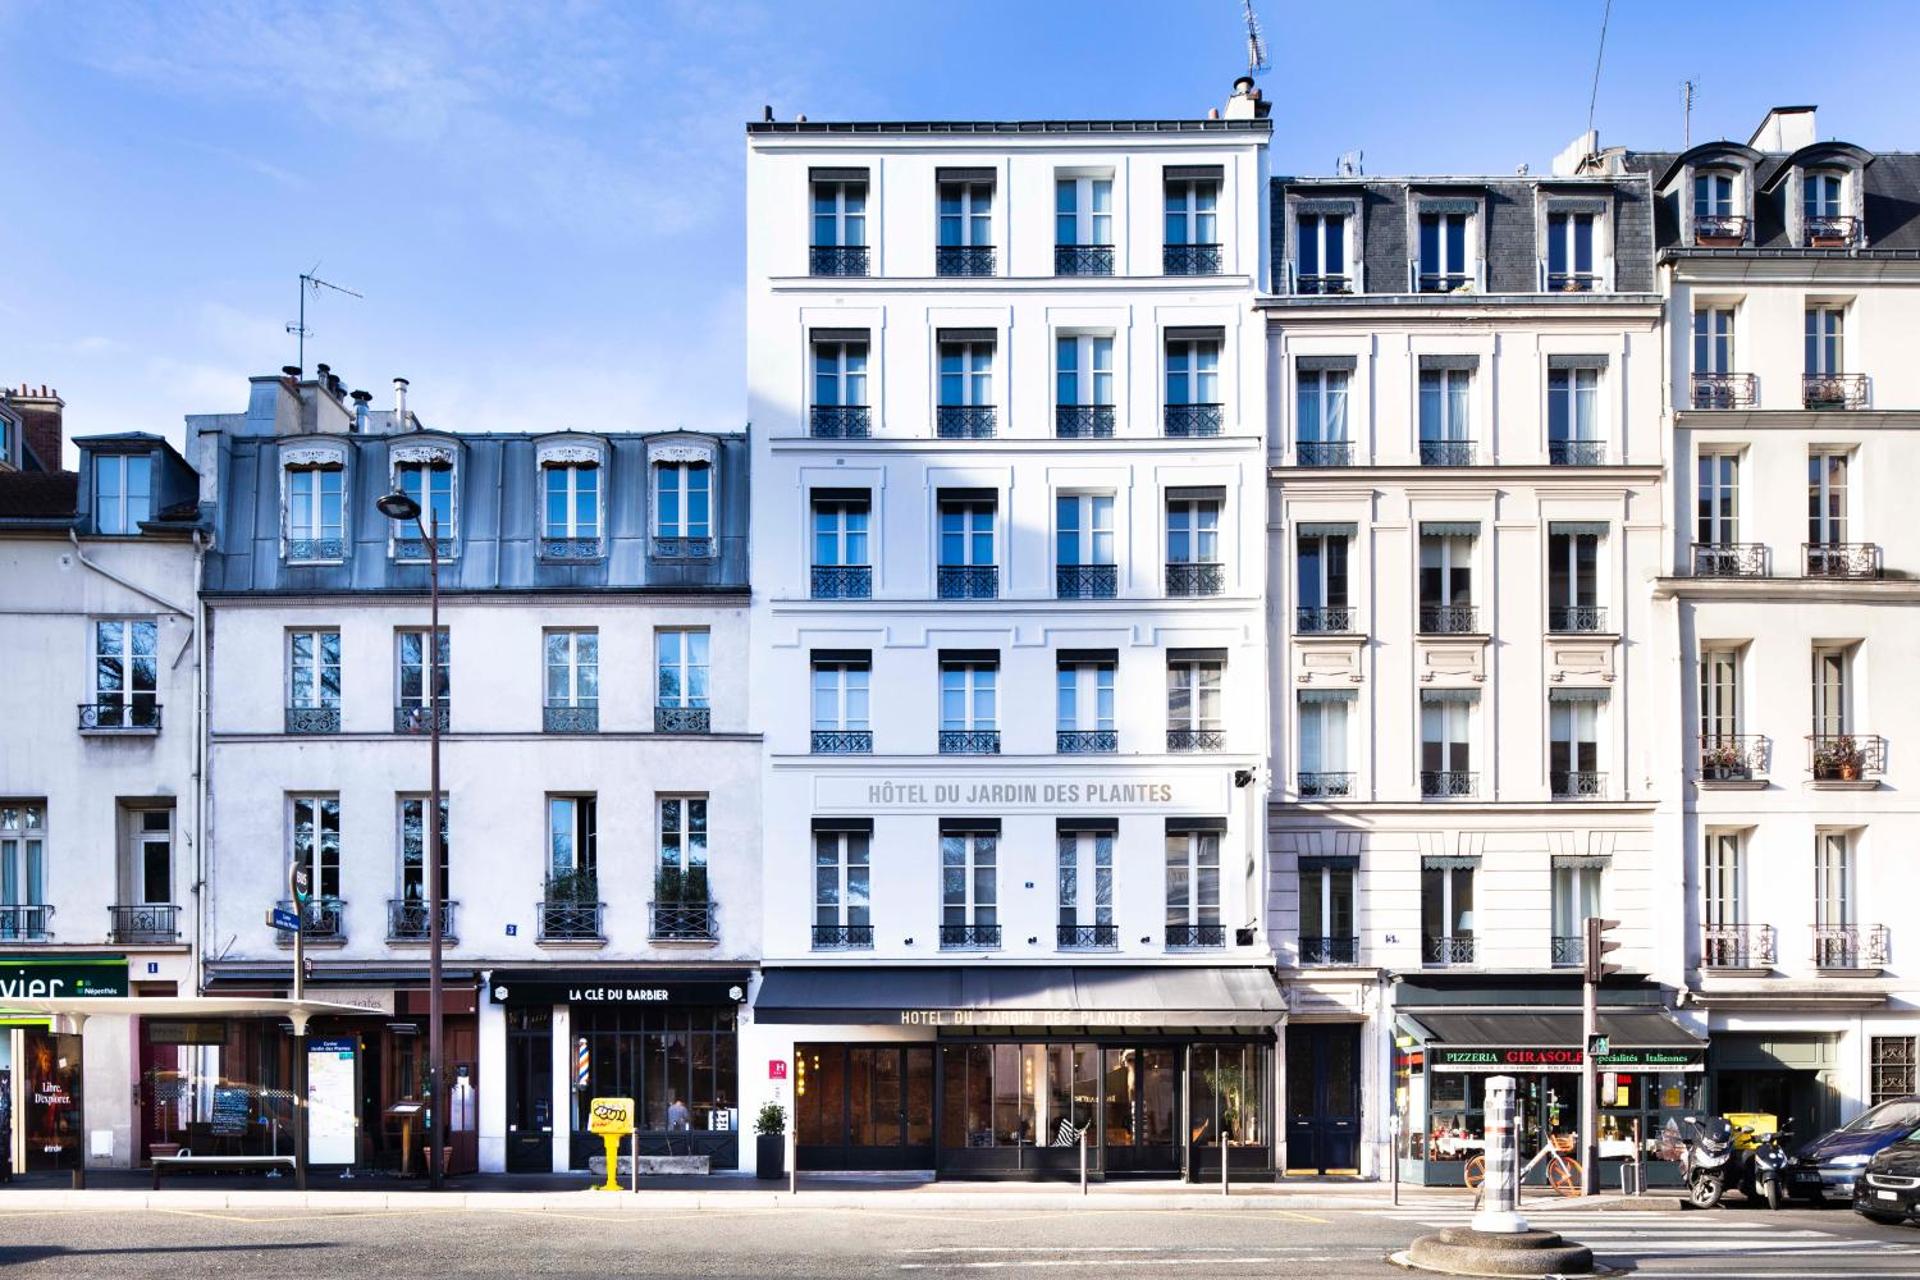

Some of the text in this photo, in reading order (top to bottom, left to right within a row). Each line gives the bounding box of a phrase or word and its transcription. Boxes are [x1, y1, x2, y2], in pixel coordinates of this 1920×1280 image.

[868, 781, 1172, 803] HÔTEL DU JARDIN DES PLANTES
[569, 987, 669, 1001] LA CLÉ DU BARBIER
[954, 1011, 973, 1024] DU
[983, 1011, 1033, 1024] JARDIN
[1044, 1011, 1071, 1024] DES
[1080, 1011, 1142, 1024] PLANTES
[1446, 1052, 1498, 1062] PIZZERIA
[1597, 1053, 1638, 1064] pecialités
